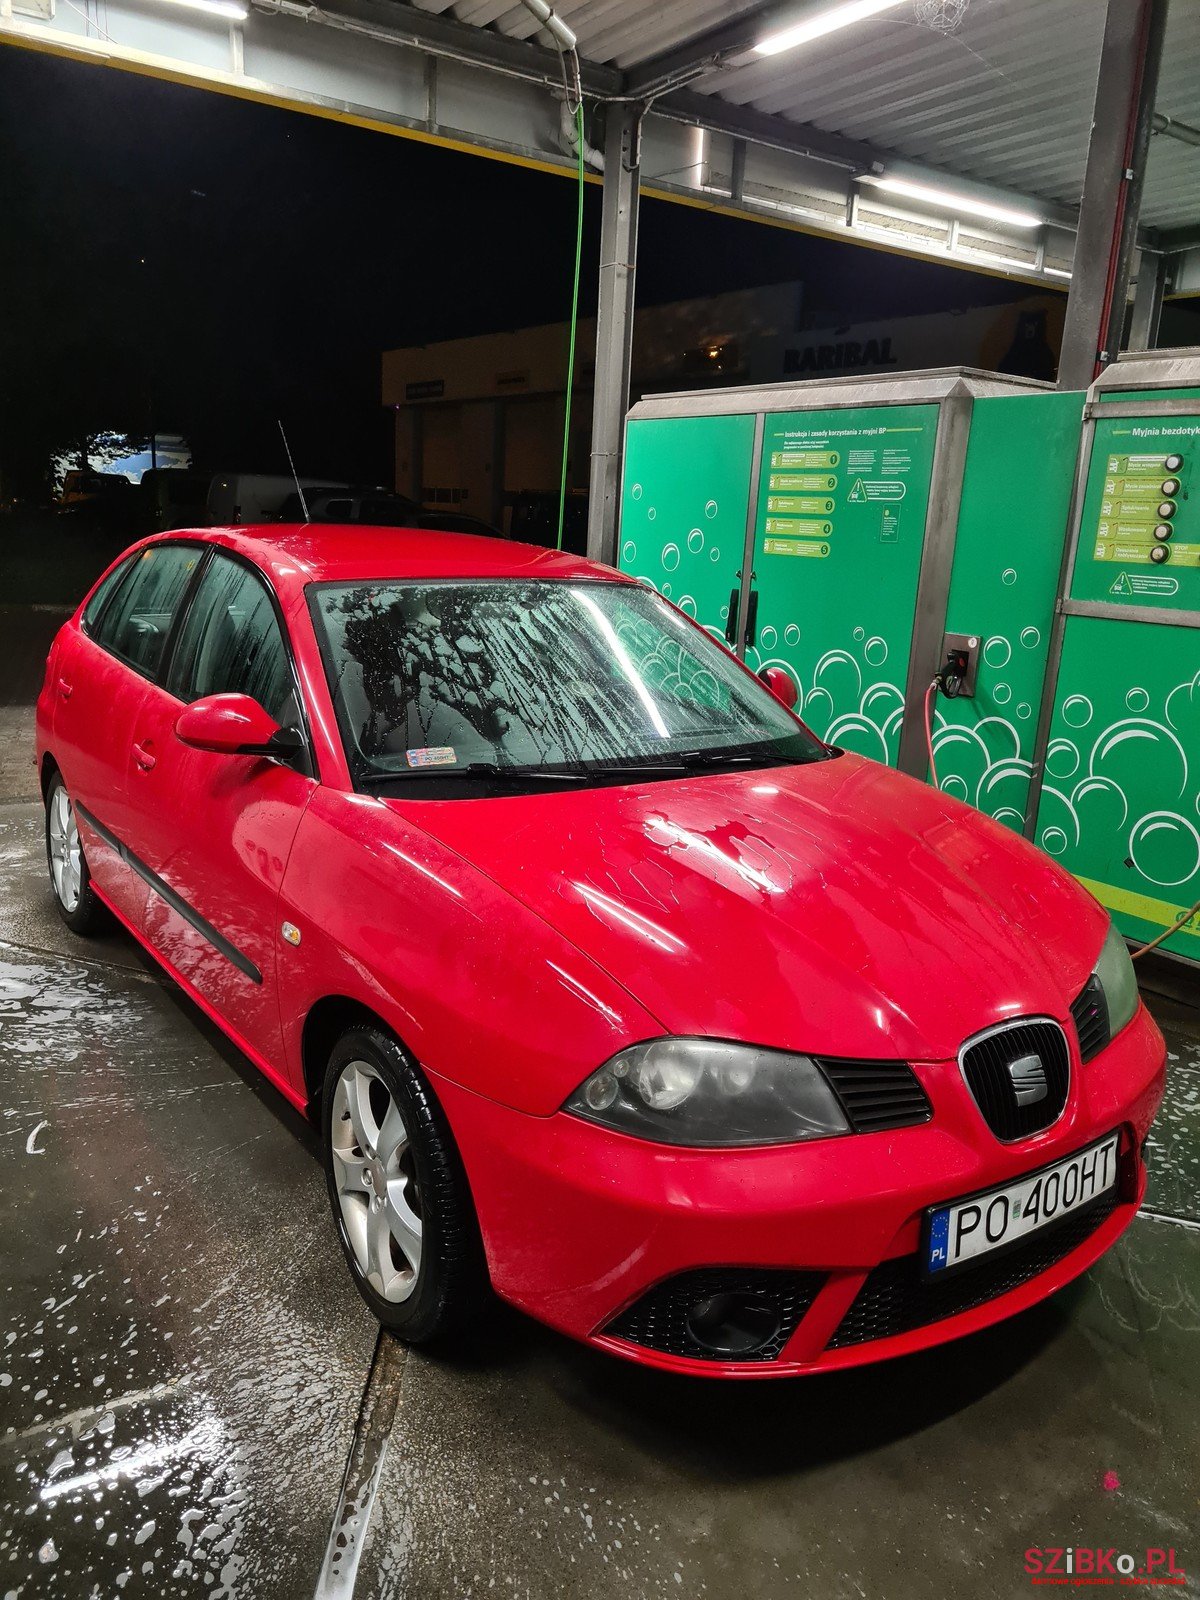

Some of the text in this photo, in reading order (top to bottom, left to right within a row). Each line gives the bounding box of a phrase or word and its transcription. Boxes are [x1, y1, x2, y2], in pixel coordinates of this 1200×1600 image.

[783, 337, 898, 374] BARIBAL
[784, 430, 808, 438] Instrukcja
[811, 430, 828, 438] zasady
[828, 428, 858, 437] korzystania
[862, 428, 878, 436] myjni
[878, 427, 887, 435] BP
[1132, 427, 1159, 437] Myjnia
[954, 1141, 1115, 1259] PO 400HT
[931, 1248, 945, 1263] PL
